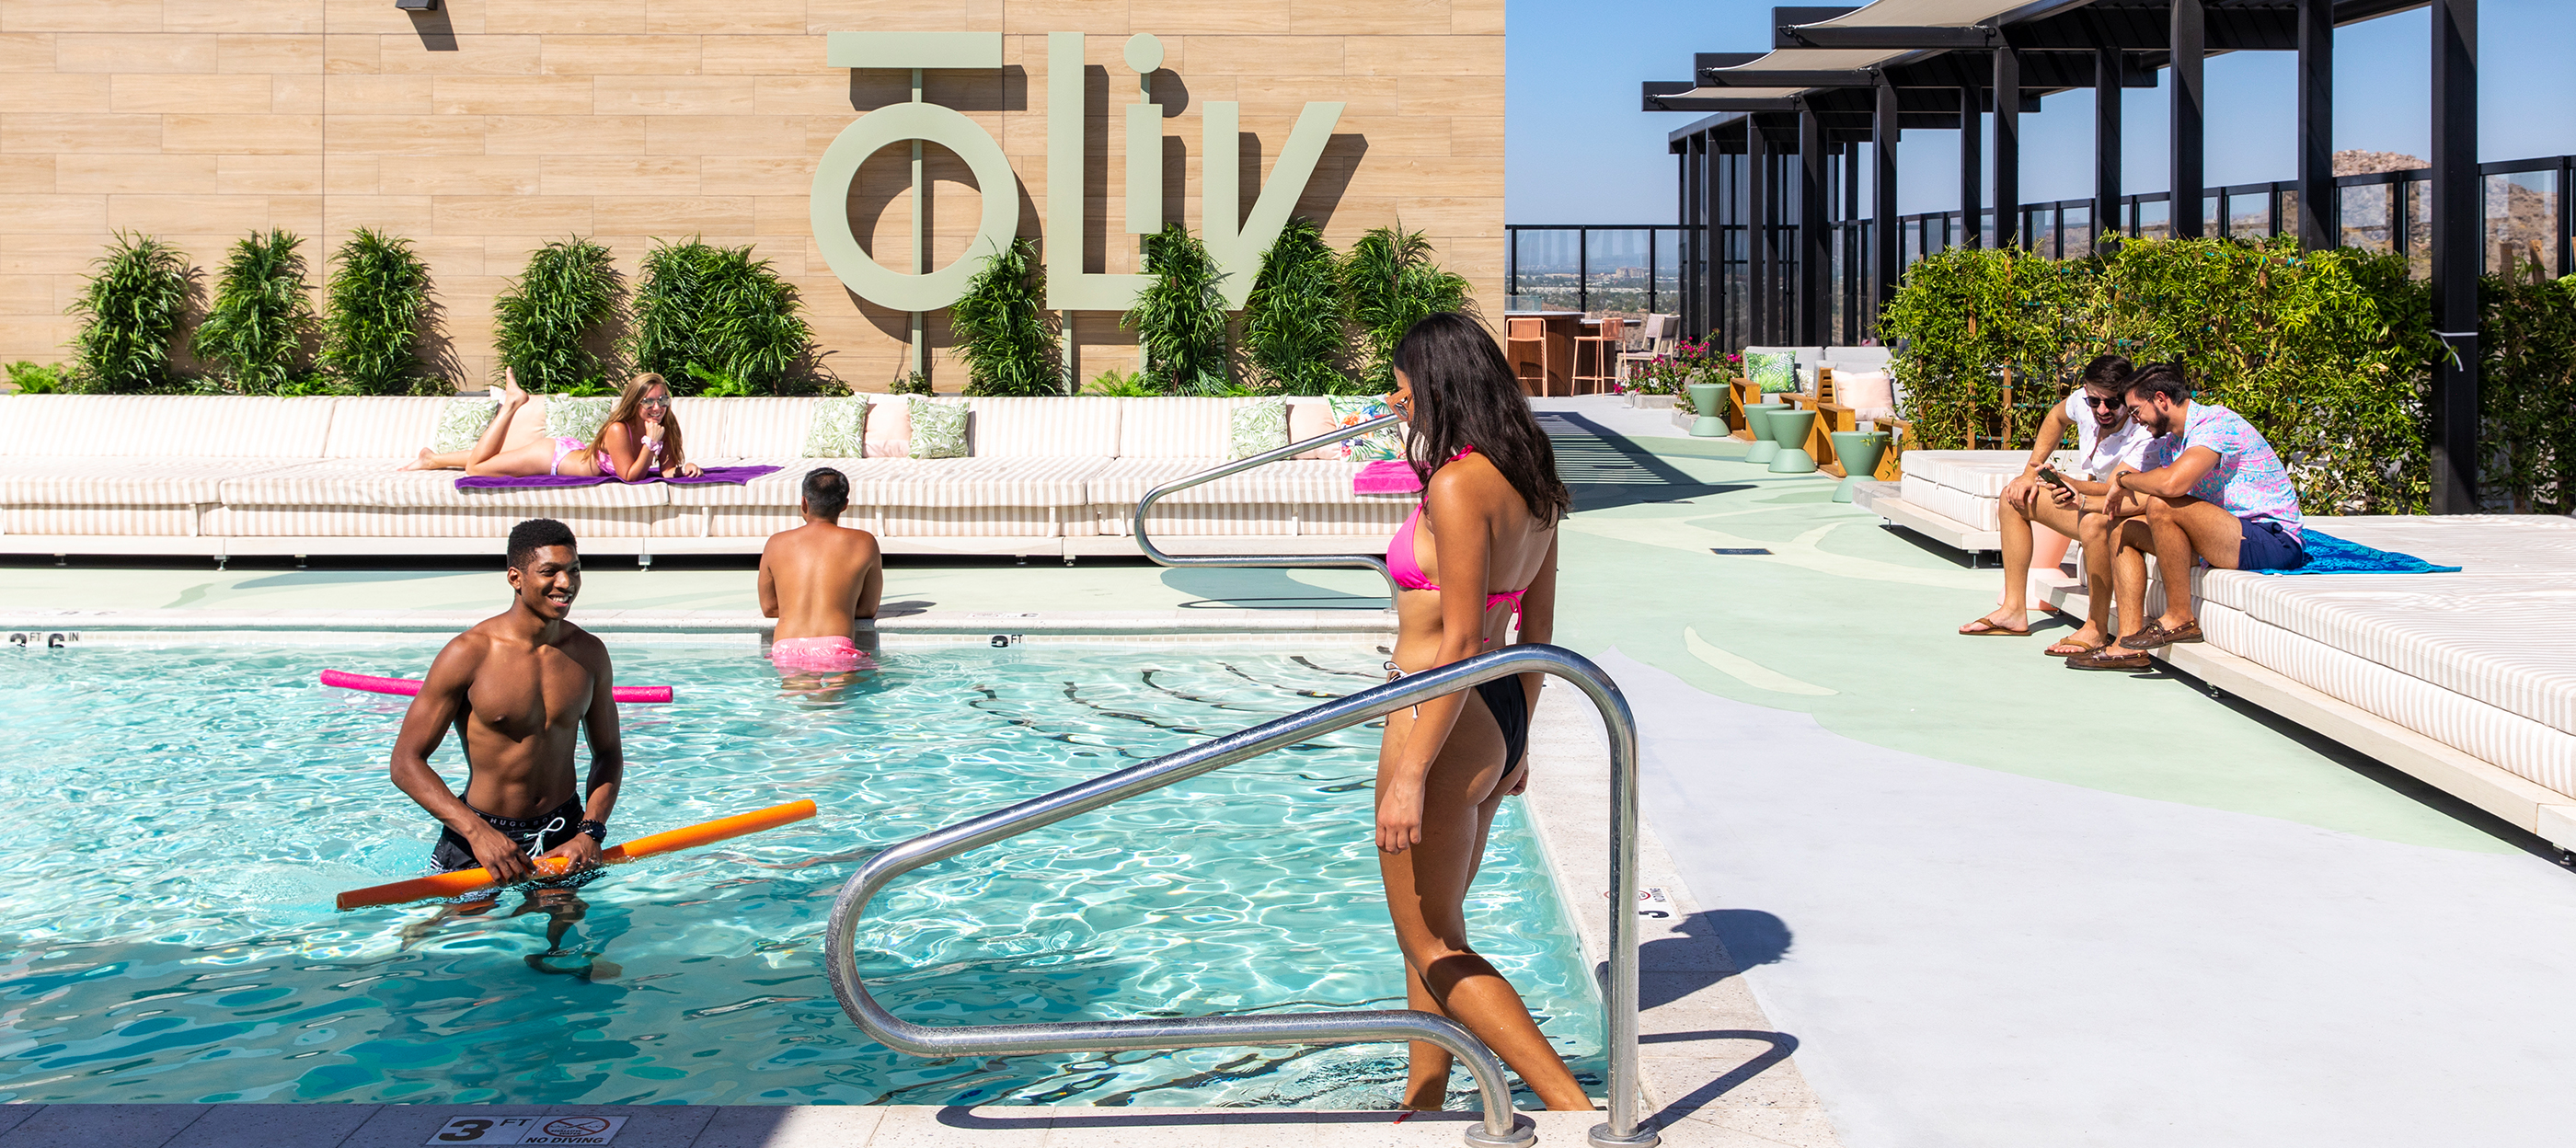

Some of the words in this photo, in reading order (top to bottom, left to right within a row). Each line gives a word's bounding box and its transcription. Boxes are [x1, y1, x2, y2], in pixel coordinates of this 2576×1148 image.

[29, 632, 41, 641] FT
[68, 632, 79, 641] IN
[1011, 634, 1023, 644] FT
[489, 818, 526, 828] HUGO
[439, 1119, 494, 1142] 3
[500, 1119, 533, 1127] FT
